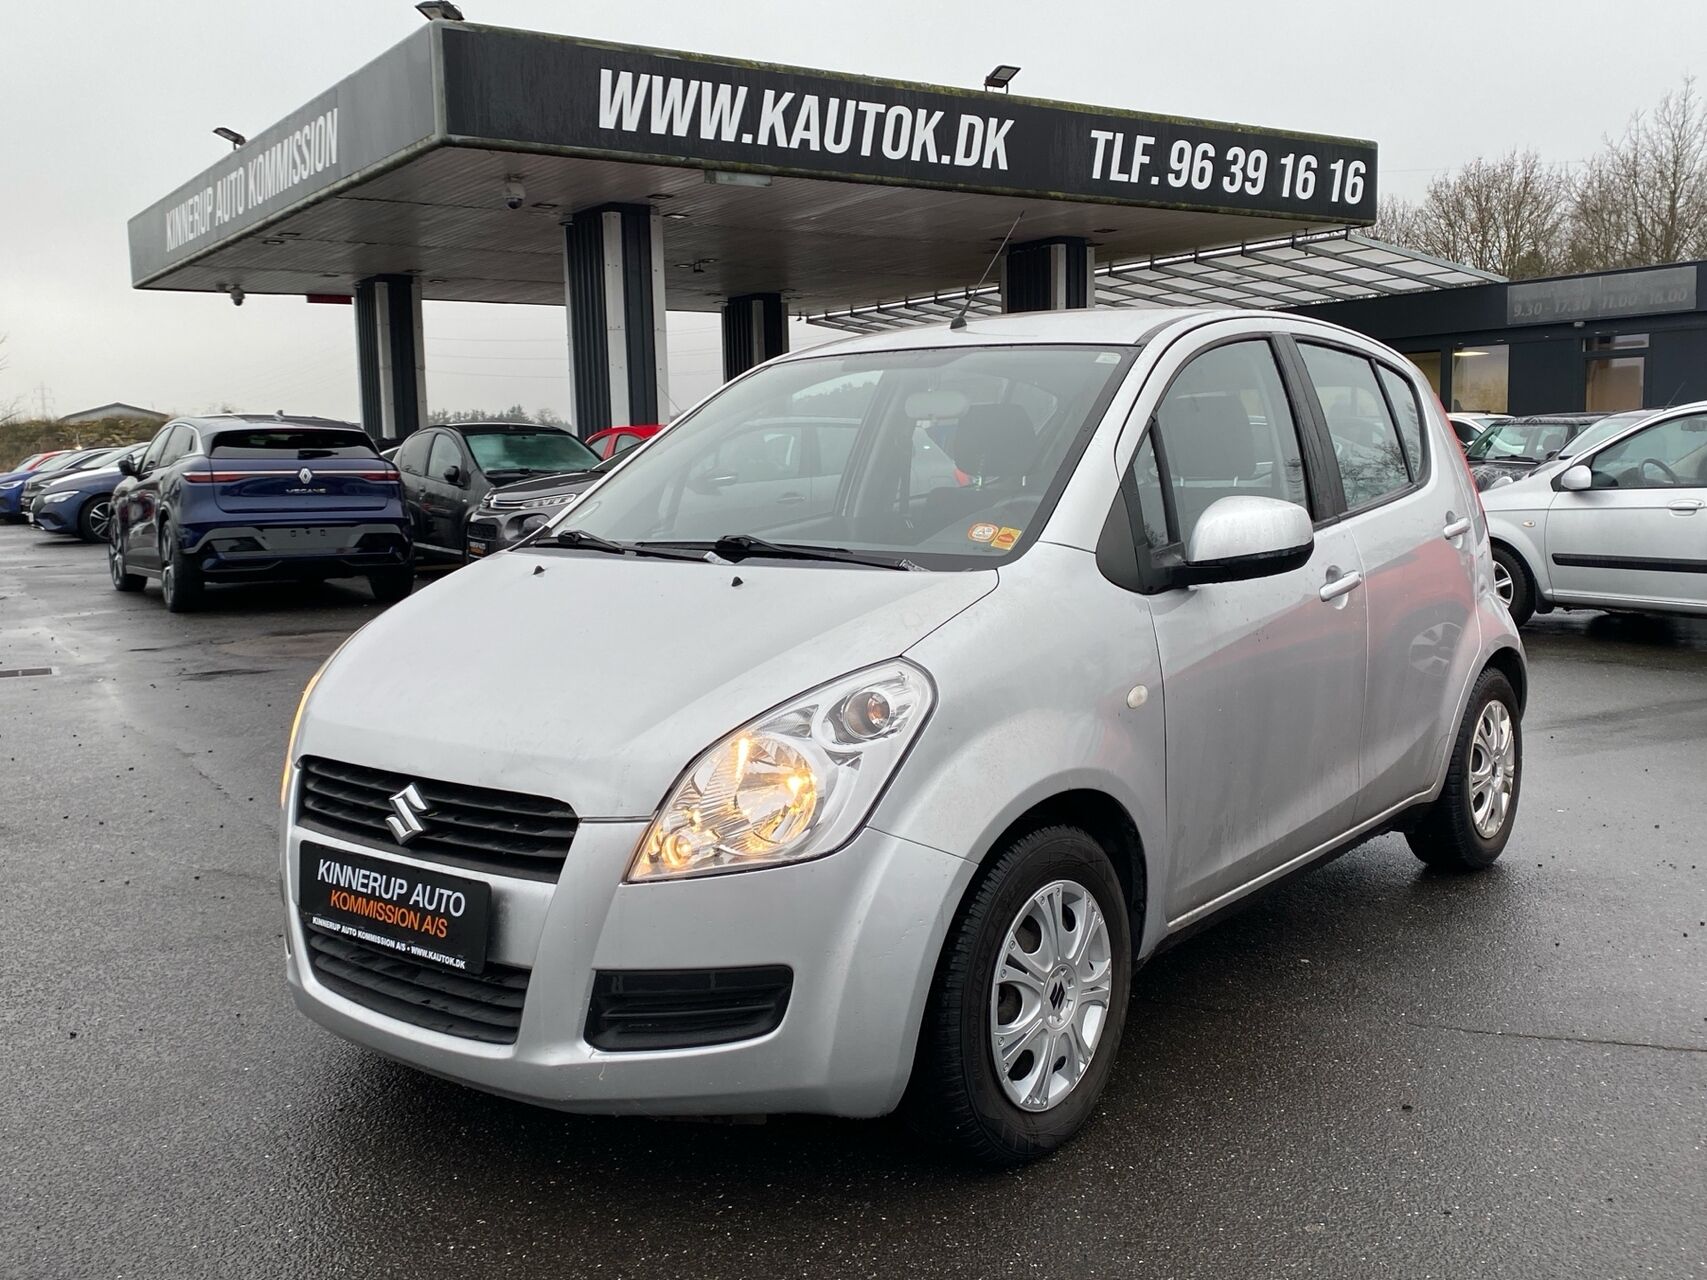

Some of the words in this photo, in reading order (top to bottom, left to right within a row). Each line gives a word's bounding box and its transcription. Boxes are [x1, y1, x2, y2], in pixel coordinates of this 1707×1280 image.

[598, 68, 1015, 170] WWW.KAUTOK.DK
[166, 186, 214, 252] KINNERUP
[215, 166, 245, 226] AUTO
[248, 107, 338, 209] KOMMISSION
[1090, 129, 1159, 185] TLF.
[1167, 139, 1216, 190] 96
[1222, 146, 1268, 196] 39
[1280, 152, 1318, 200] 16
[1329, 158, 1367, 205] 16
[317, 858, 408, 901] KINNERUP
[409, 883, 466, 917] AUTO
[330, 889, 420, 931] KOMMISSION
[422, 914, 448, 938] A/S
[312, 916, 341, 932] KINNERUP
[341, 924, 357, 937] AUTO
[357, 929, 395, 949] KOMMISSION
[395, 940, 406, 952] A/S
[411, 945, 466, 970] WWW.KAUTOK.DK
